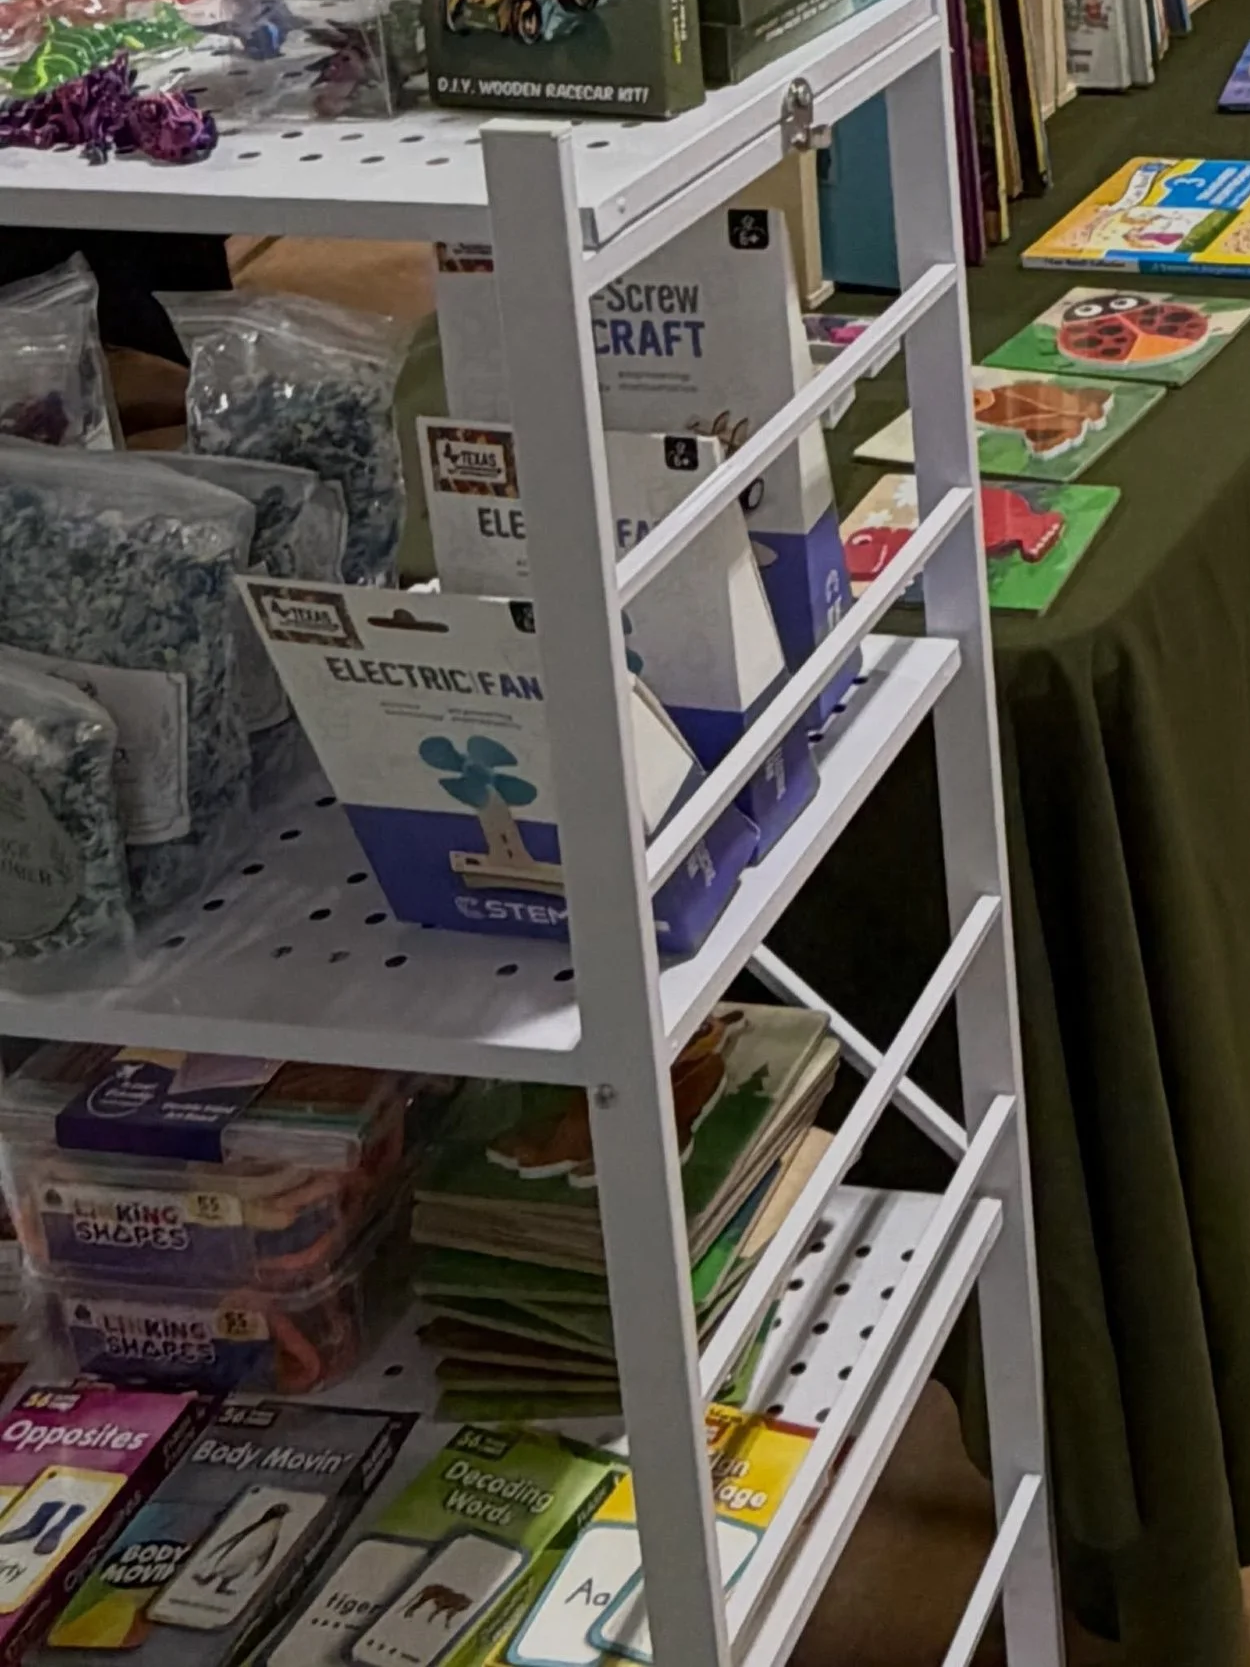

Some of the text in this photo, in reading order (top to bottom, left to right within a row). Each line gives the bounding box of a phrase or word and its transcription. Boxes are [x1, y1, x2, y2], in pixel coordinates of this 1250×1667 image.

[436, 76, 650, 104] D.I.Y. WOODEN RACECAR KIT!
[591, 281, 699, 315] -Screw
[591, 318, 706, 359] CRAFT
[460, 448, 497, 468] TEXAS
[615, 518, 662, 549] FA
[324, 655, 545, 703] ELECTRIC FAN
[72, 1197, 181, 1226] LIKING
[75, 1222, 190, 1250] SHAPES
[105, 1335, 216, 1365] SHAPES
[2, 1418, 149, 1452] Opposites
[192, 1438, 353, 1474] Body Movin'
[708, 1451, 750, 1478] ign
[444, 1460, 554, 1513] Decoding
[446, 1489, 514, 1526] Words
[122, 1544, 191, 1564] BODY
[325, 1591, 380, 1616] tiger
[564, 1577, 611, 1607] Aa
